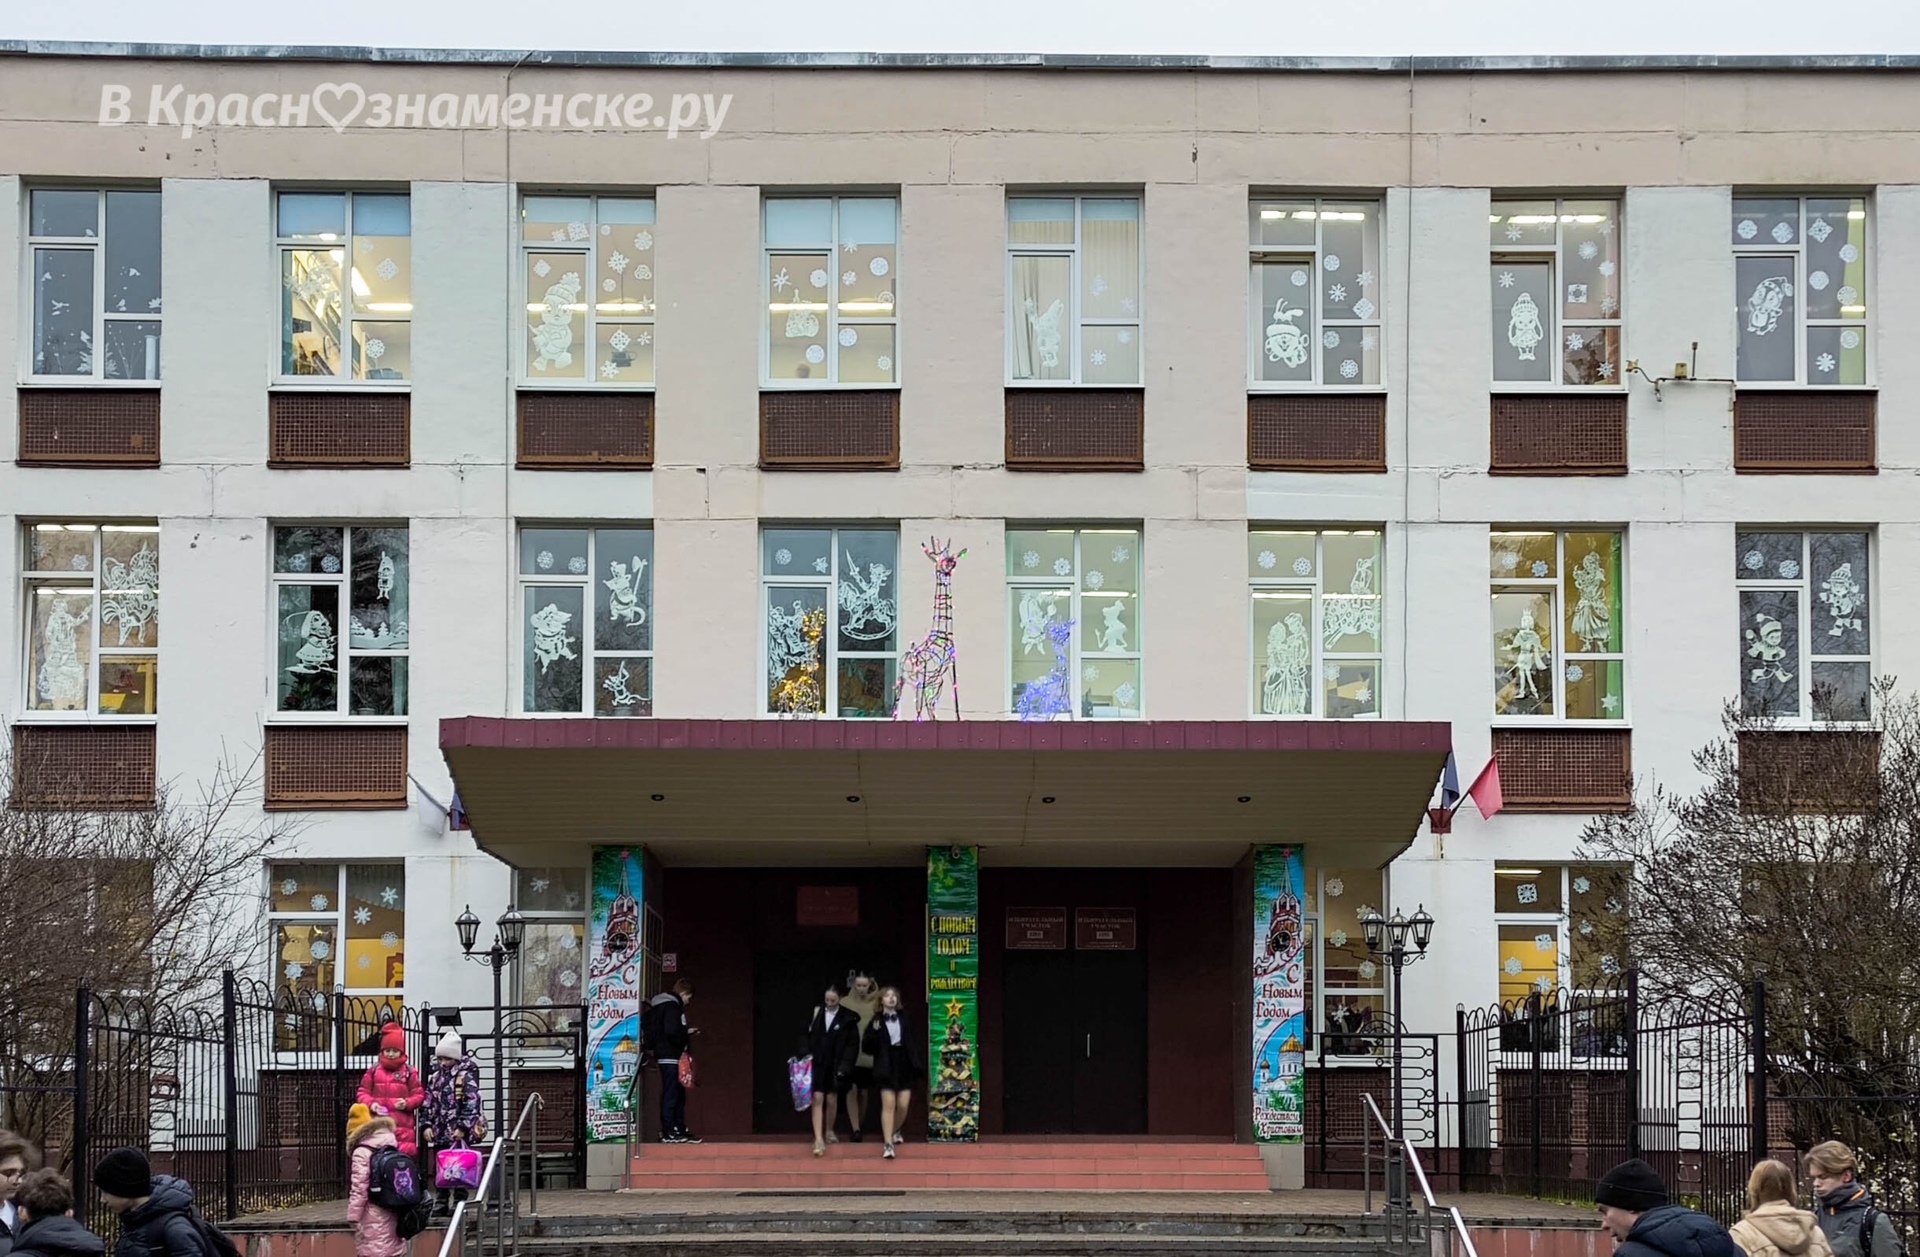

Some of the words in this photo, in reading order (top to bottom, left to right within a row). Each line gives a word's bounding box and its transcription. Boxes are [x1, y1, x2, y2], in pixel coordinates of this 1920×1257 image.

[931, 916, 938, 933] С
[937, 938, 970, 956] ГОДОМ
[623, 965, 635, 985] С
[1287, 964, 1299, 984] С
[597, 984, 638, 1000] Новым
[1262, 983, 1302, 998] Новым
[590, 1002, 625, 1019] Годом
[1256, 1001, 1290, 1018] Годом
[589, 1108, 632, 1122] Рождество
[1255, 1107, 1299, 1121] Рождеством
